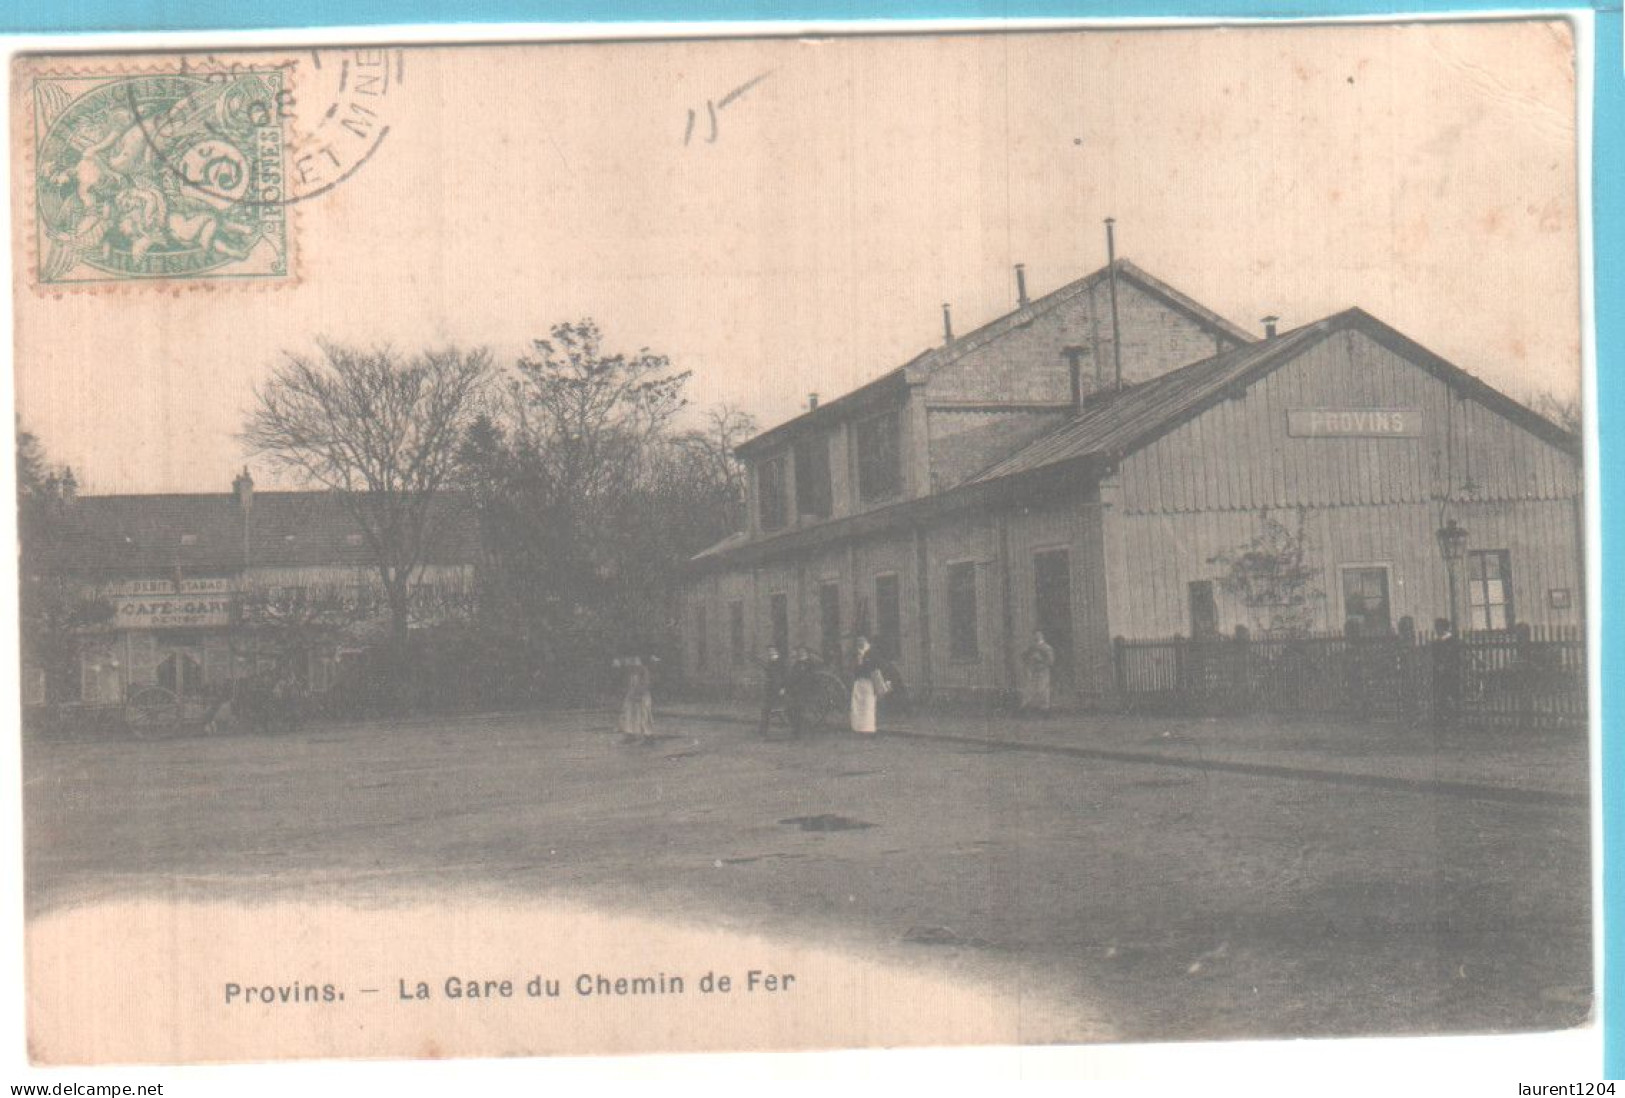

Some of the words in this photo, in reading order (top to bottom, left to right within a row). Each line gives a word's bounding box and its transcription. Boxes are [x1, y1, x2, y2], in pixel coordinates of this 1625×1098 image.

[261, 130, 281, 216] POSTES
[1310, 411, 1403, 432] PROVINS
[225, 980, 345, 1004] Provins.
[399, 978, 429, 1000] La
[445, 976, 513, 999] Gare
[527, 975, 560, 997] du
[575, 973, 684, 996] Chemin
[700, 971, 732, 993] de
[747, 970, 796, 991] Fer
